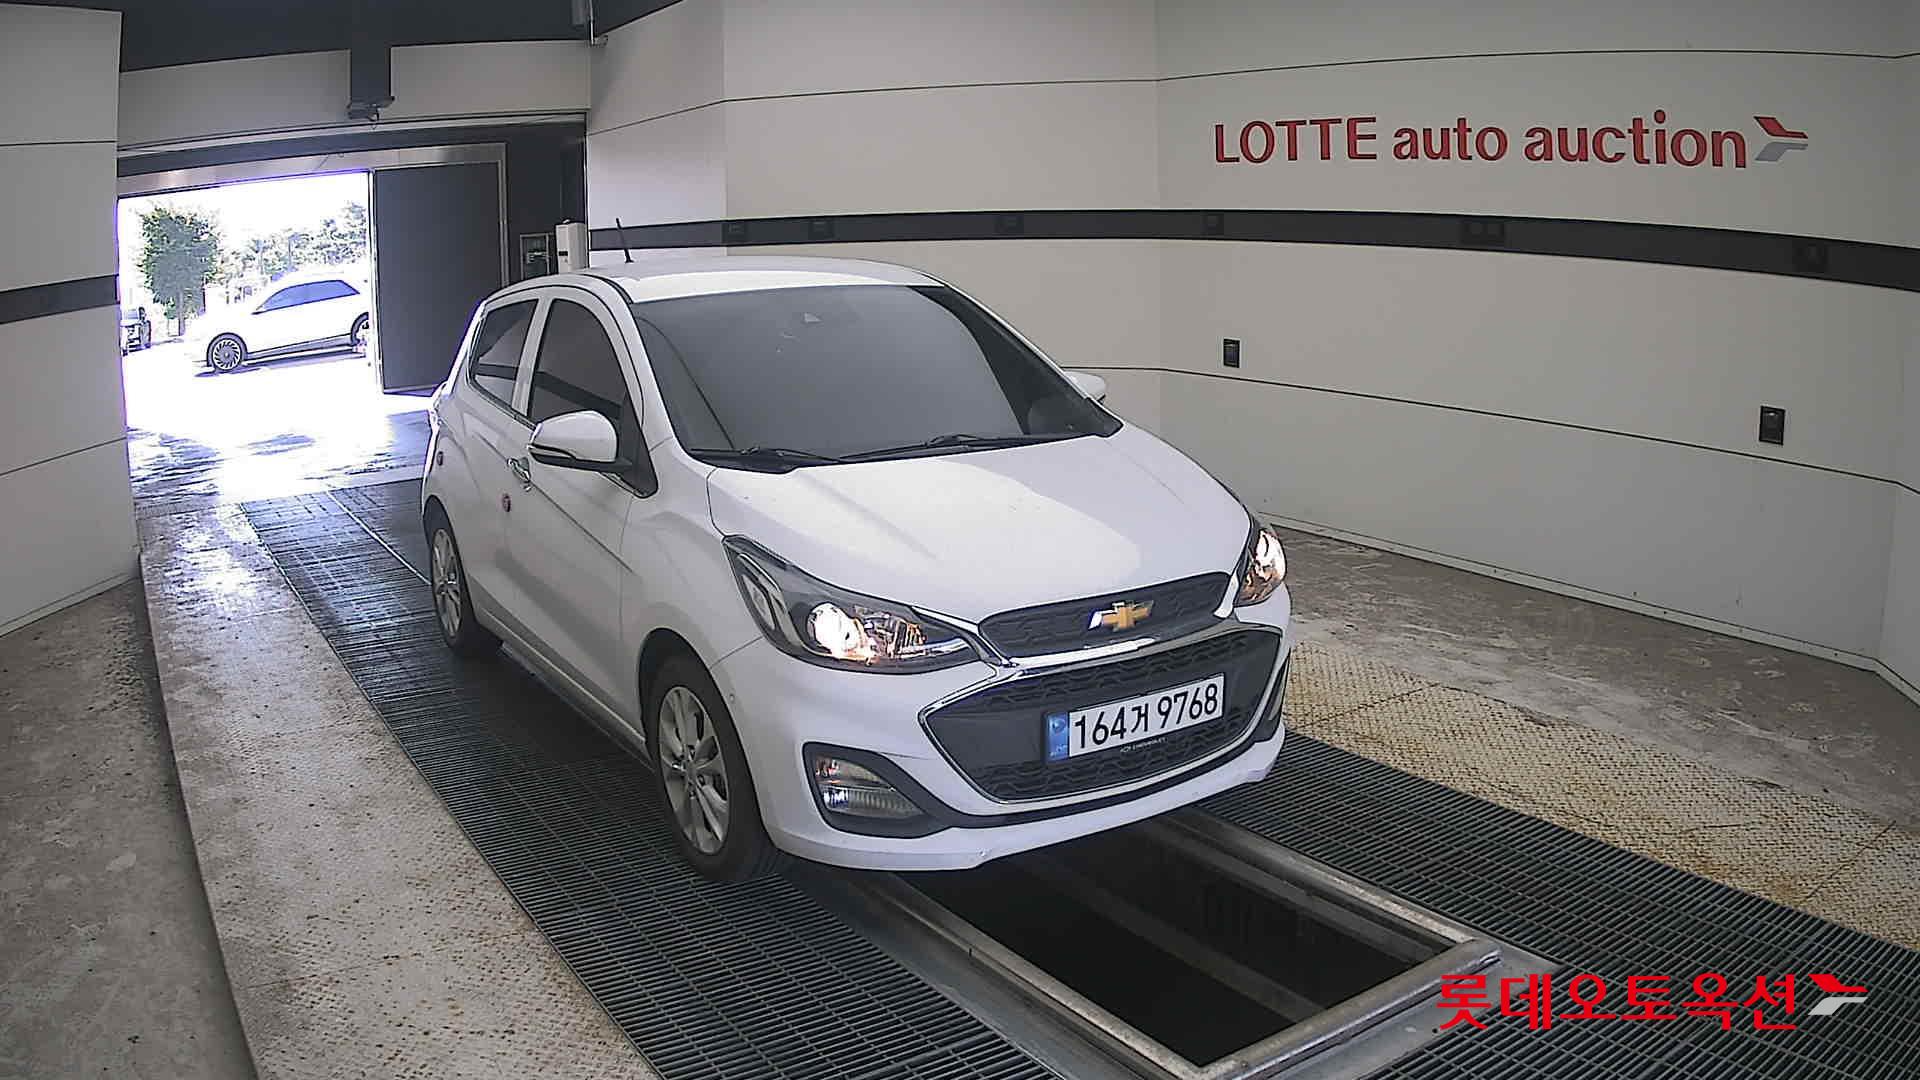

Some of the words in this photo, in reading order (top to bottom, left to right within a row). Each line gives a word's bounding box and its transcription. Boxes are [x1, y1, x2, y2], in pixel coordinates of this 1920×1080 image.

[1215, 116, 1377, 164] LOTTE
[1393, 117, 1508, 160] auto
[1525, 109, 1747, 168] auction
[1157, 683, 1218, 729] 9768
